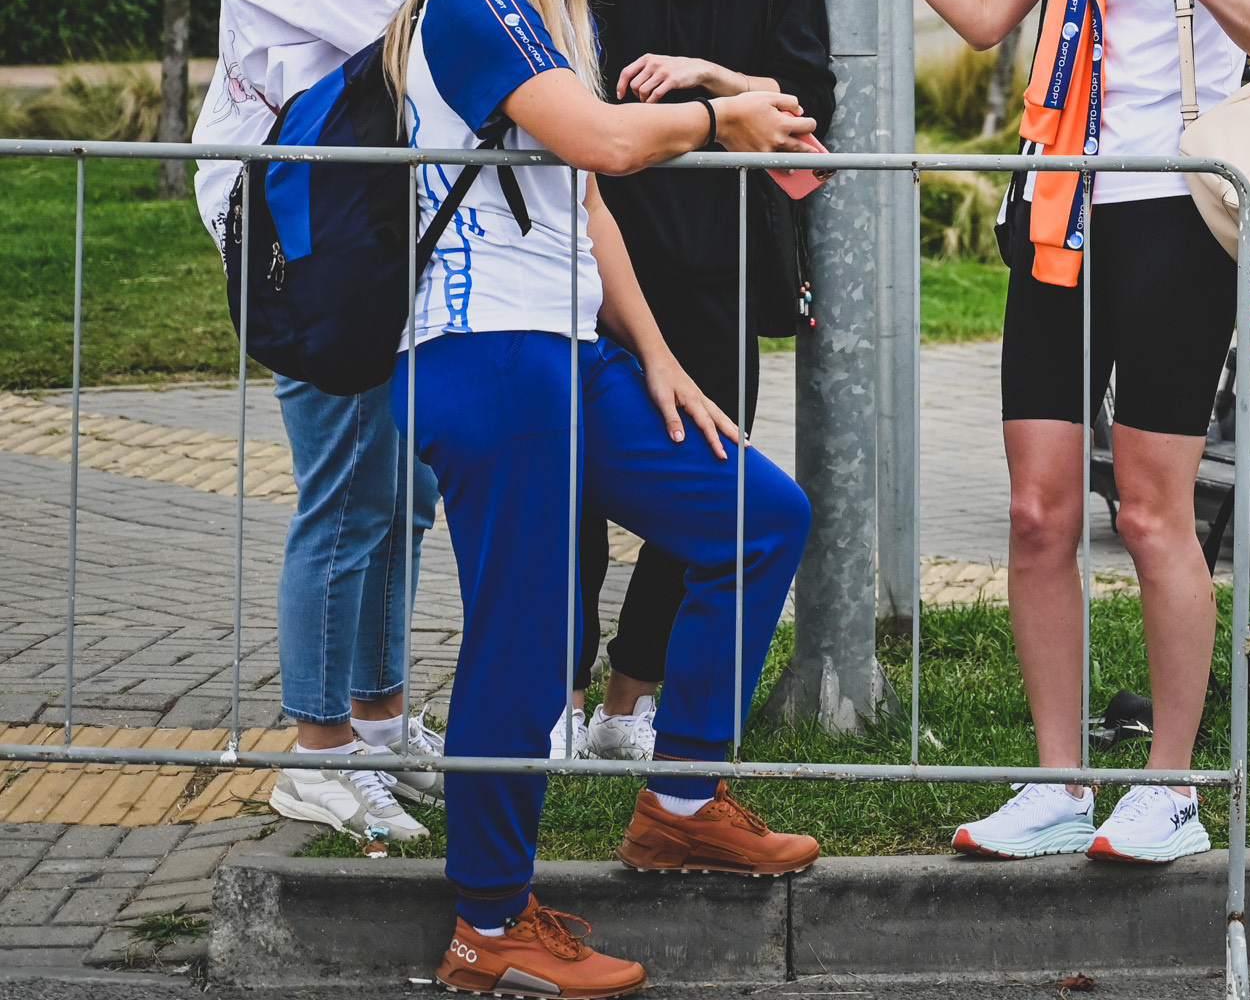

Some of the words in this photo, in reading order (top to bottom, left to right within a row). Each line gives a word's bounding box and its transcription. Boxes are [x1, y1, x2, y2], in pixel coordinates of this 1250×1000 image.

[514, 26, 546, 67] ОРТО-СПОРТ
[1050, 42, 1069, 106] ОРТО-СПОРТ
[1089, 71, 1099, 135] ОРТО-СПОРТ
